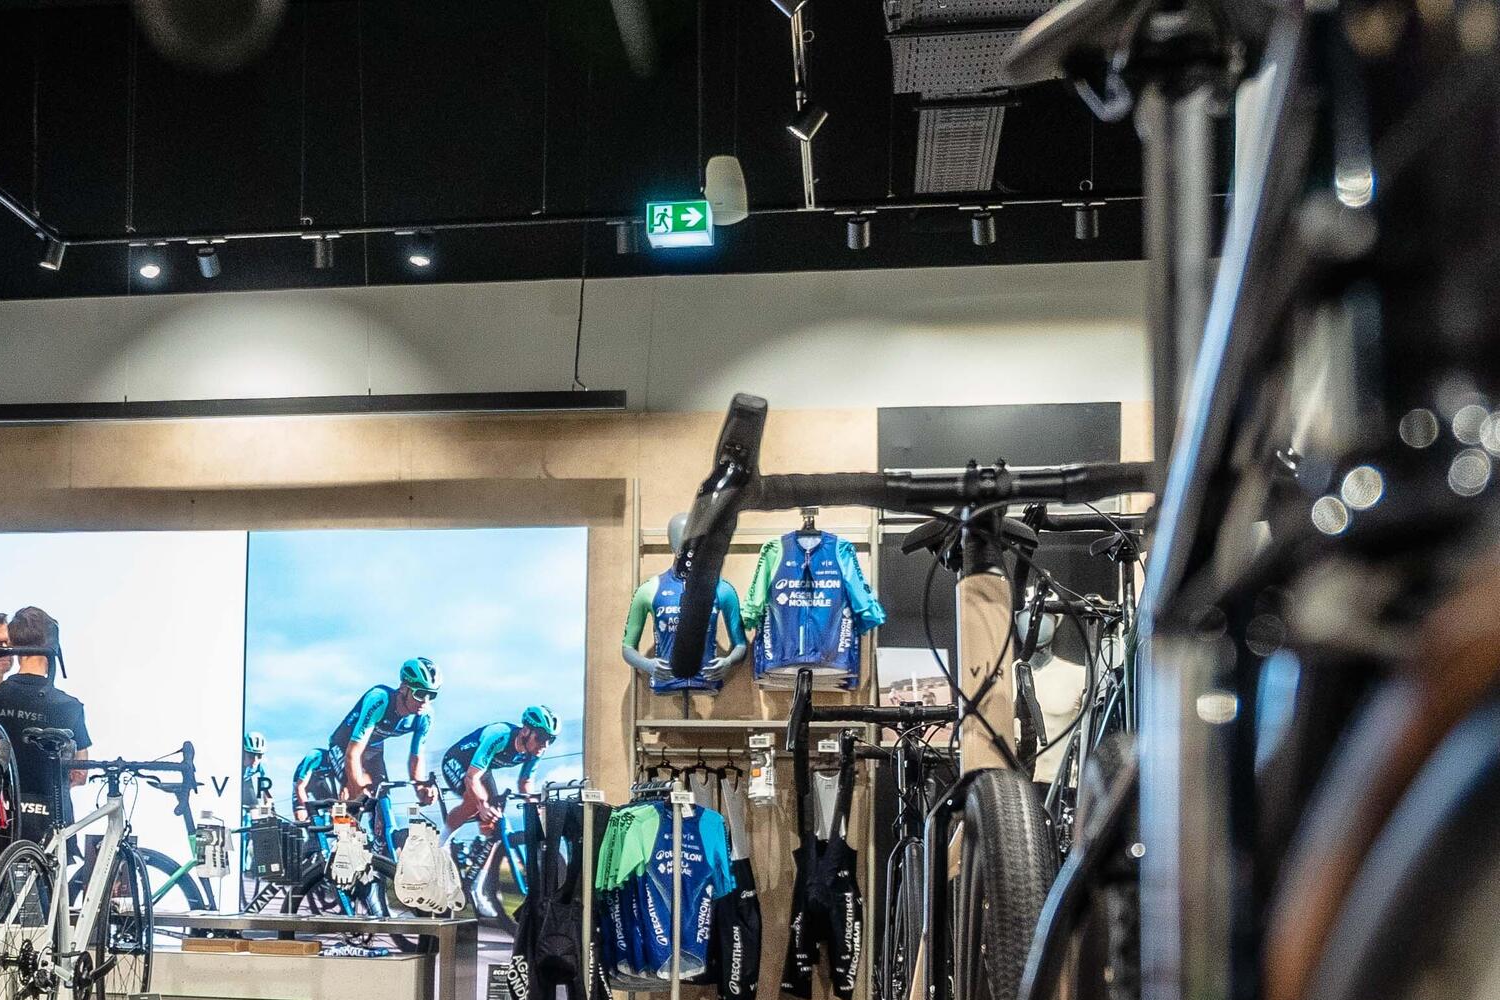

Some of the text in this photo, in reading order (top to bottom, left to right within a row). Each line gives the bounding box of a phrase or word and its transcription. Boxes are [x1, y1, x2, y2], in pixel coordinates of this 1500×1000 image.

[211, 776, 230, 798] V
[19, 801, 50, 816] YSEL
[247, 888, 275, 914] VAN
[730, 926, 742, 982] DECATHLON
